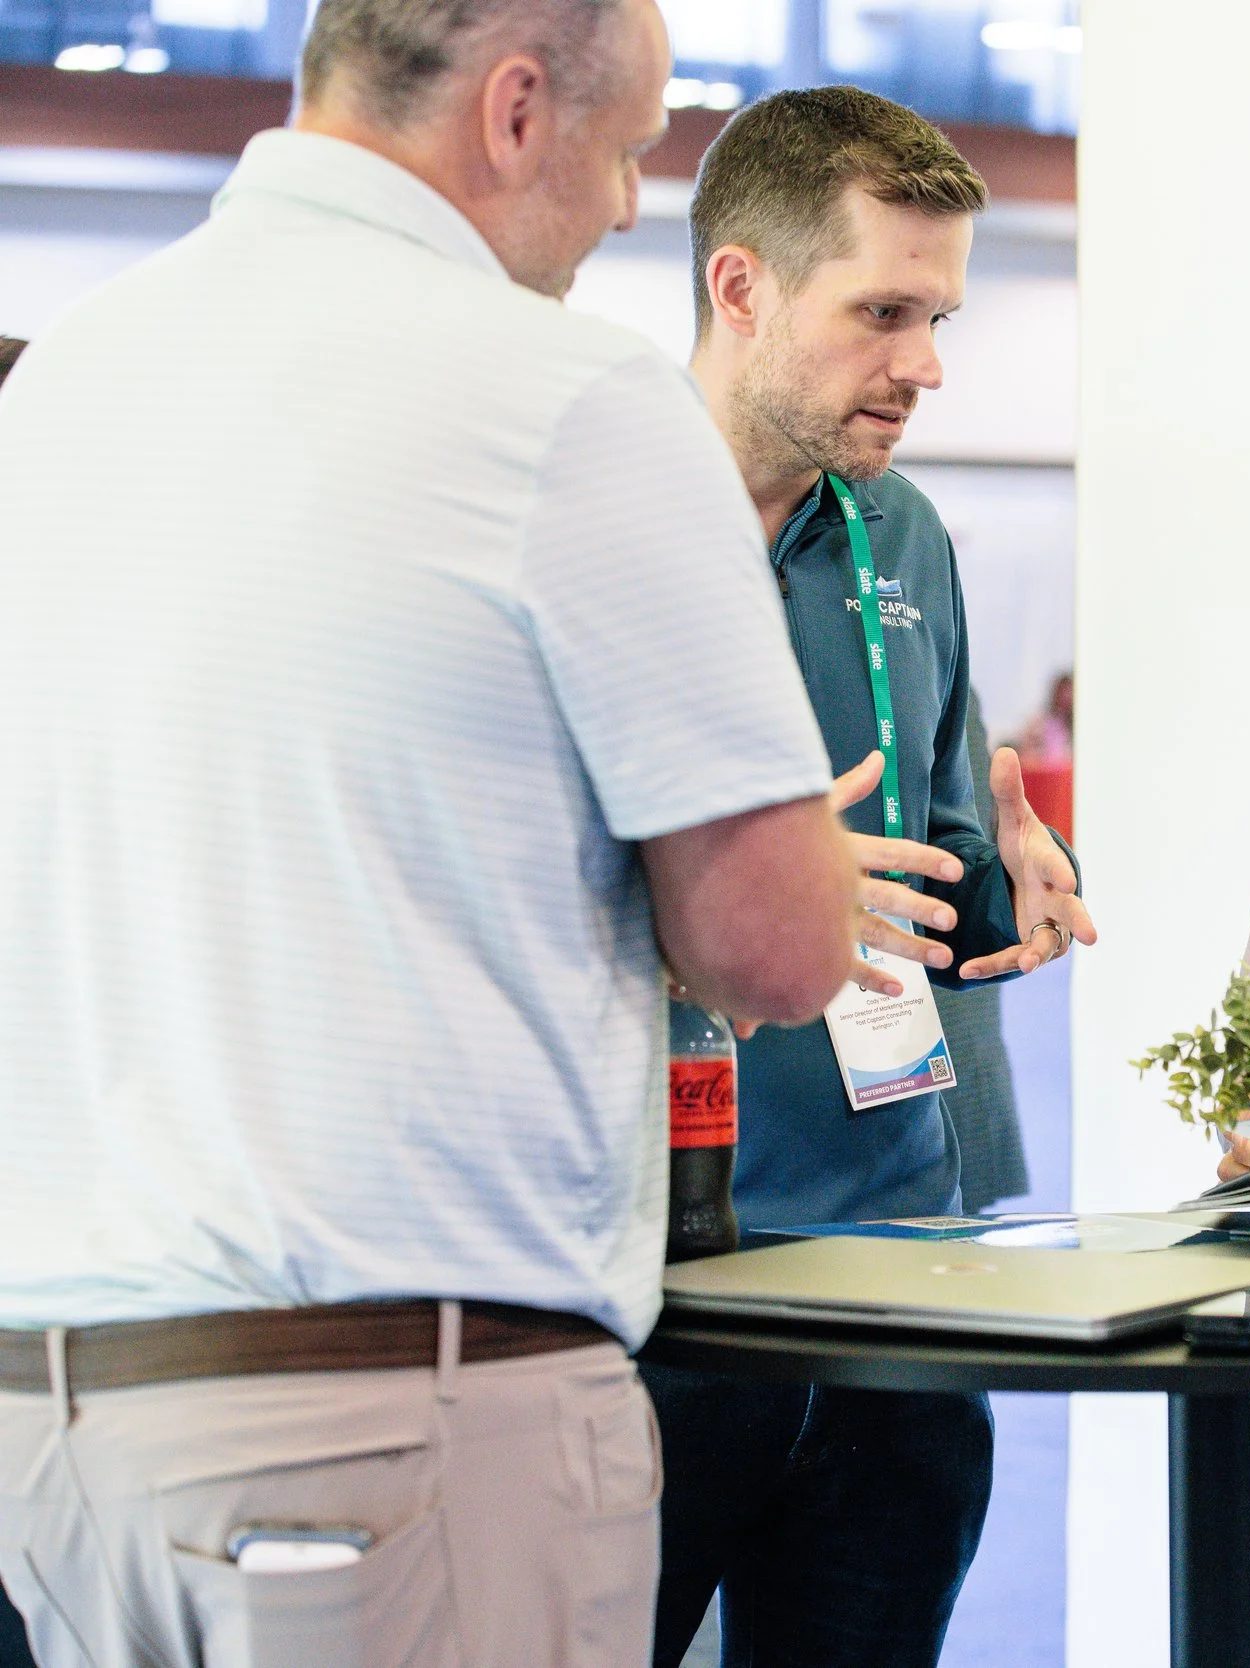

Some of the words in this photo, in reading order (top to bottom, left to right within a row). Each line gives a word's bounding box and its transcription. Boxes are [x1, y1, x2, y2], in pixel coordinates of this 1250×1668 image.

[841, 496, 857, 520] slate
[858, 567, 873, 595] slate
[878, 601, 922, 620] CAPTAIN
[879, 615, 913, 629] NSULTING
[870, 643, 883, 671] slate
[880, 719, 894, 747] slate
[886, 796, 899, 824] slate
[840, 1013, 854, 1021] Senior
[854, 1009, 873, 1018] Director
[879, 1002, 903, 1012] Marketing
[903, 997, 924, 1007] Strategy
[867, 1015, 886, 1024] Captain
[886, 1009, 913, 1020] Consulting
[859, 1086, 890, 1098] PREFERRED
[889, 1080, 915, 1092] PARTNER
